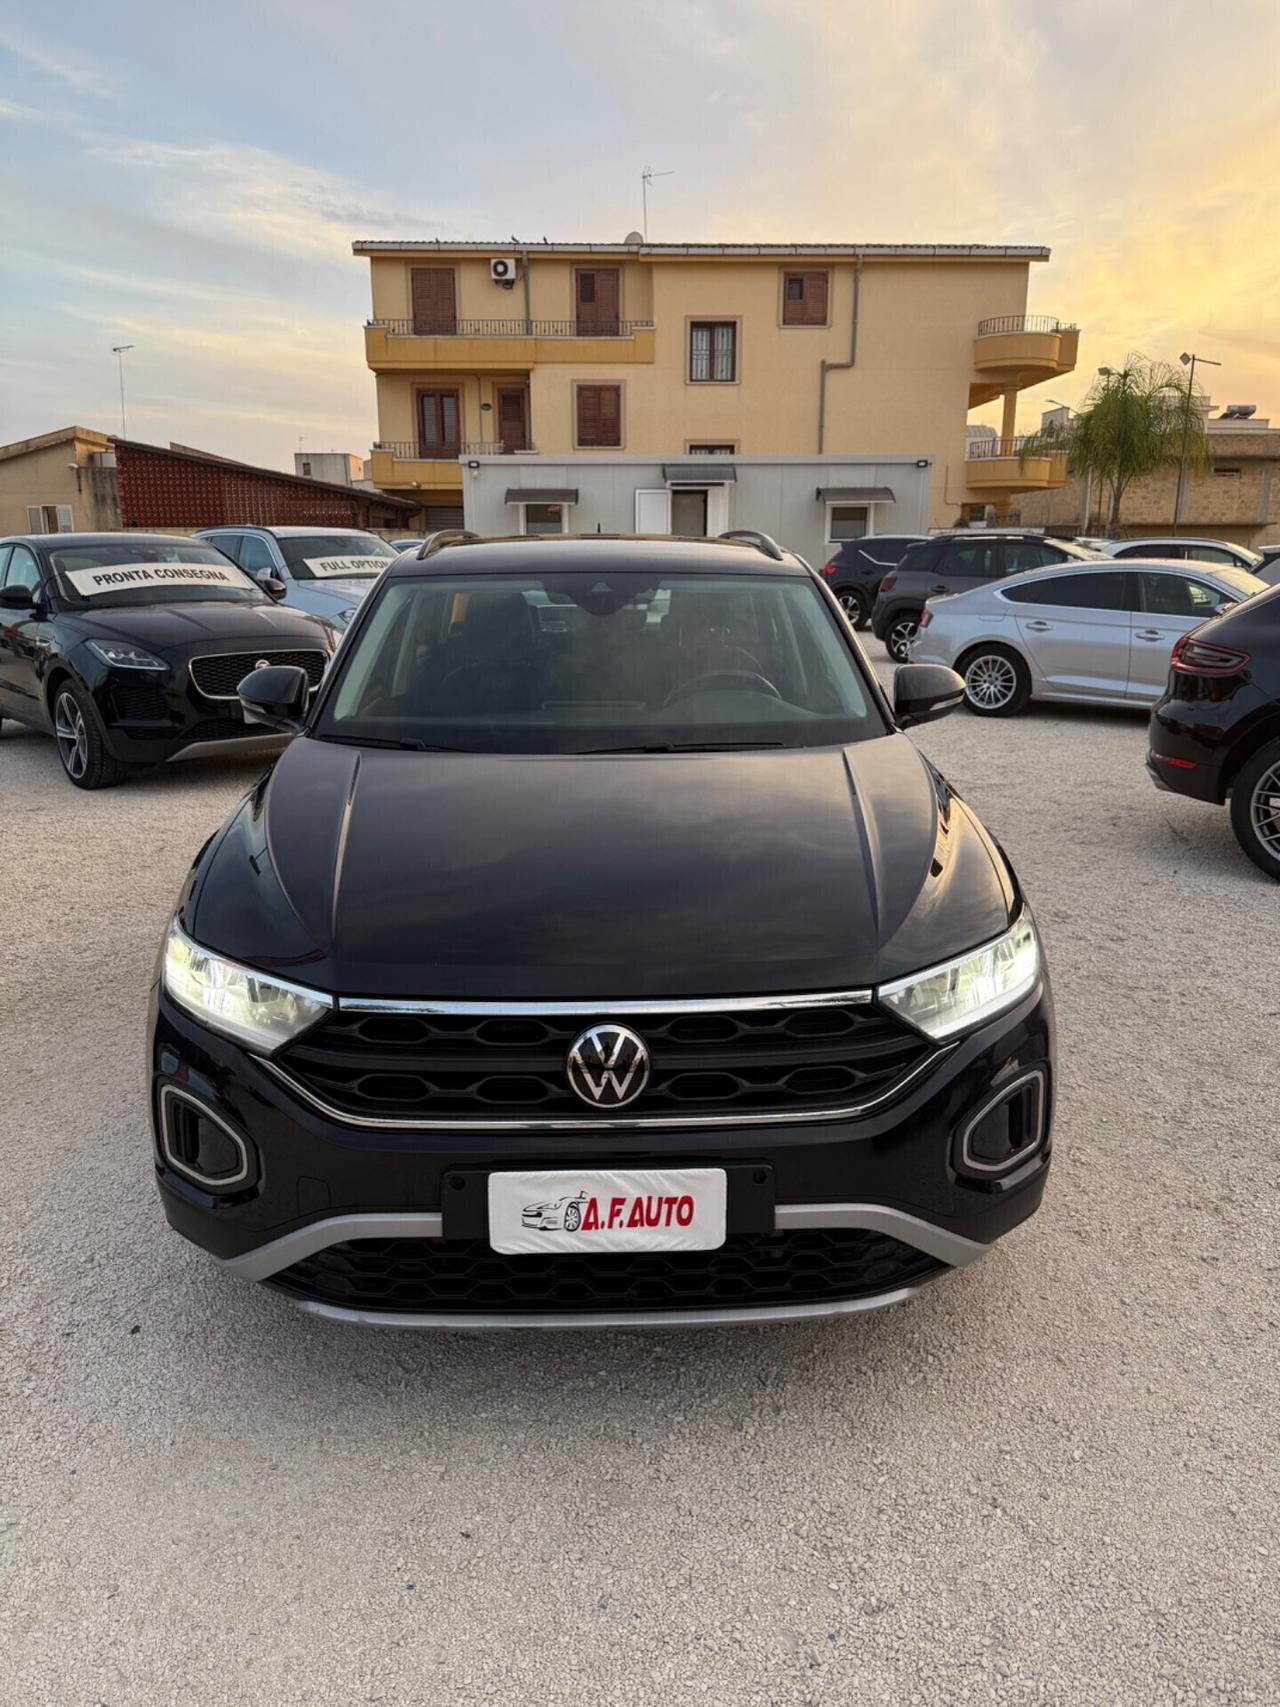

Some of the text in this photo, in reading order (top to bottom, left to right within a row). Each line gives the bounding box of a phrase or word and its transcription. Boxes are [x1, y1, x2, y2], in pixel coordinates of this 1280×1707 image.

[320, 561, 351, 572] FULL
[92, 568, 230, 586] PRONTA CONSEGNA
